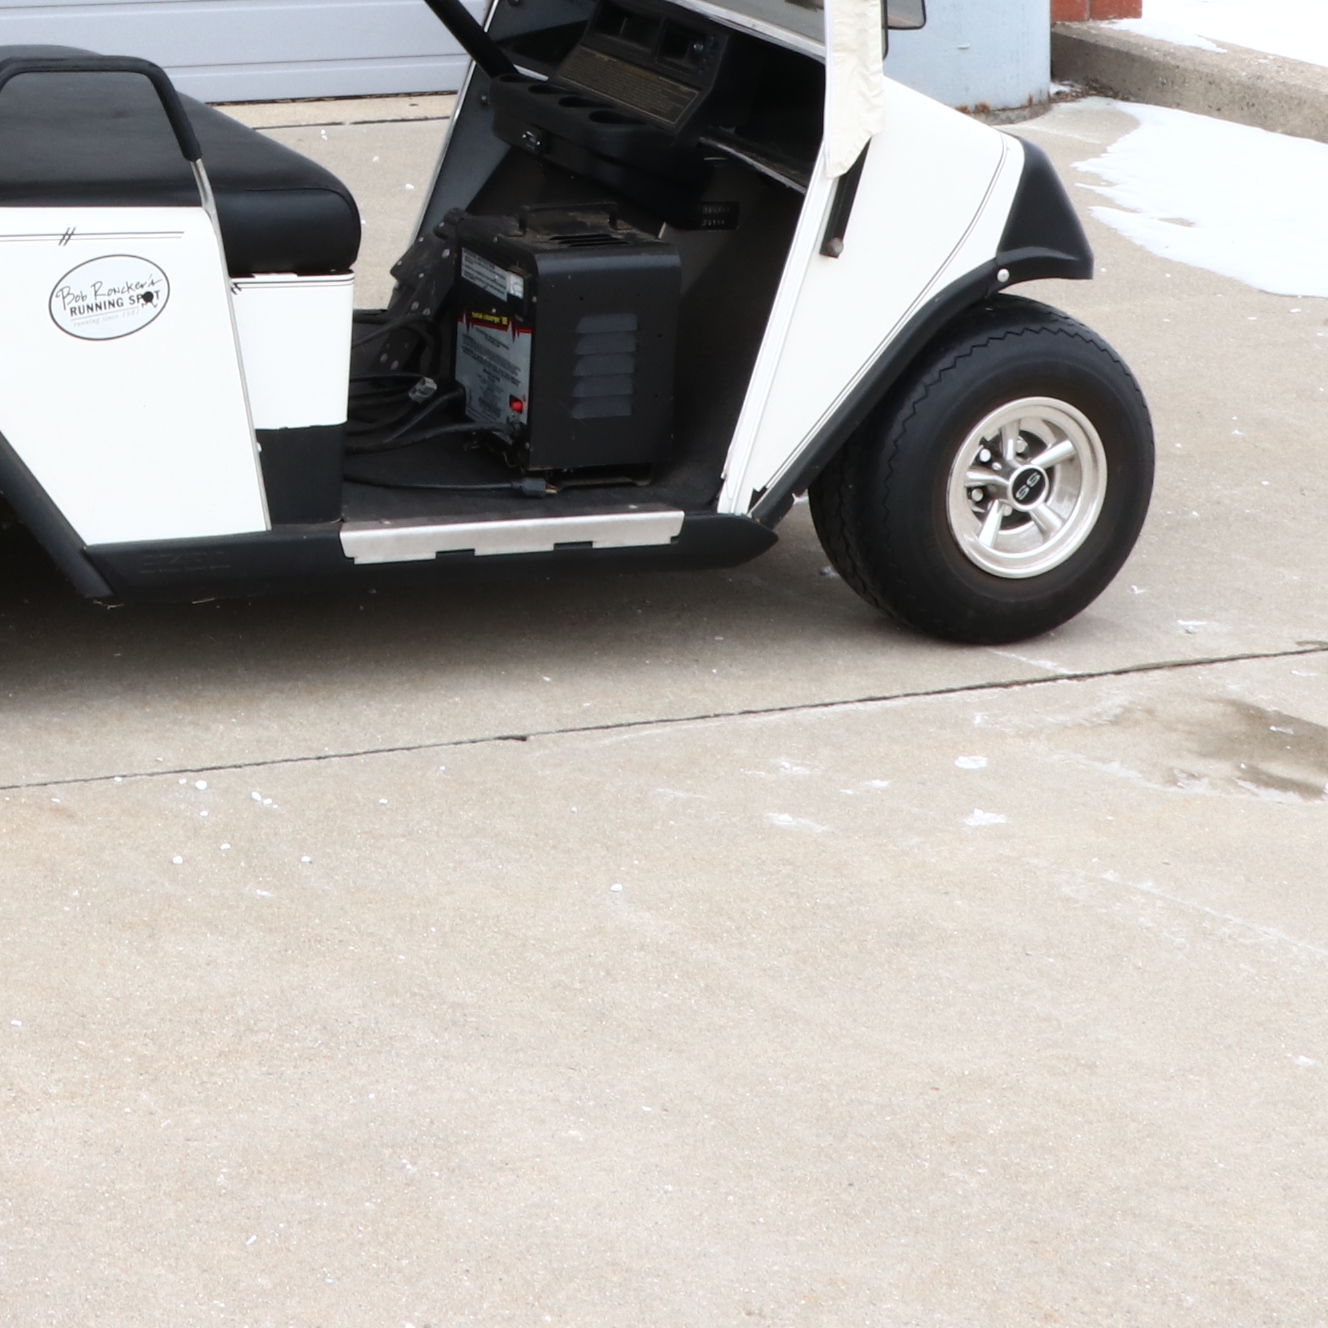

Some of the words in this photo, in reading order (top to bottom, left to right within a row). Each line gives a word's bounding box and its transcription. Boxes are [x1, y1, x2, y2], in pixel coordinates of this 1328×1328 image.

[55, 285, 88, 311] Bob
[69, 298, 124, 317] RUNNING
[1015, 472, 1041, 501] SS
